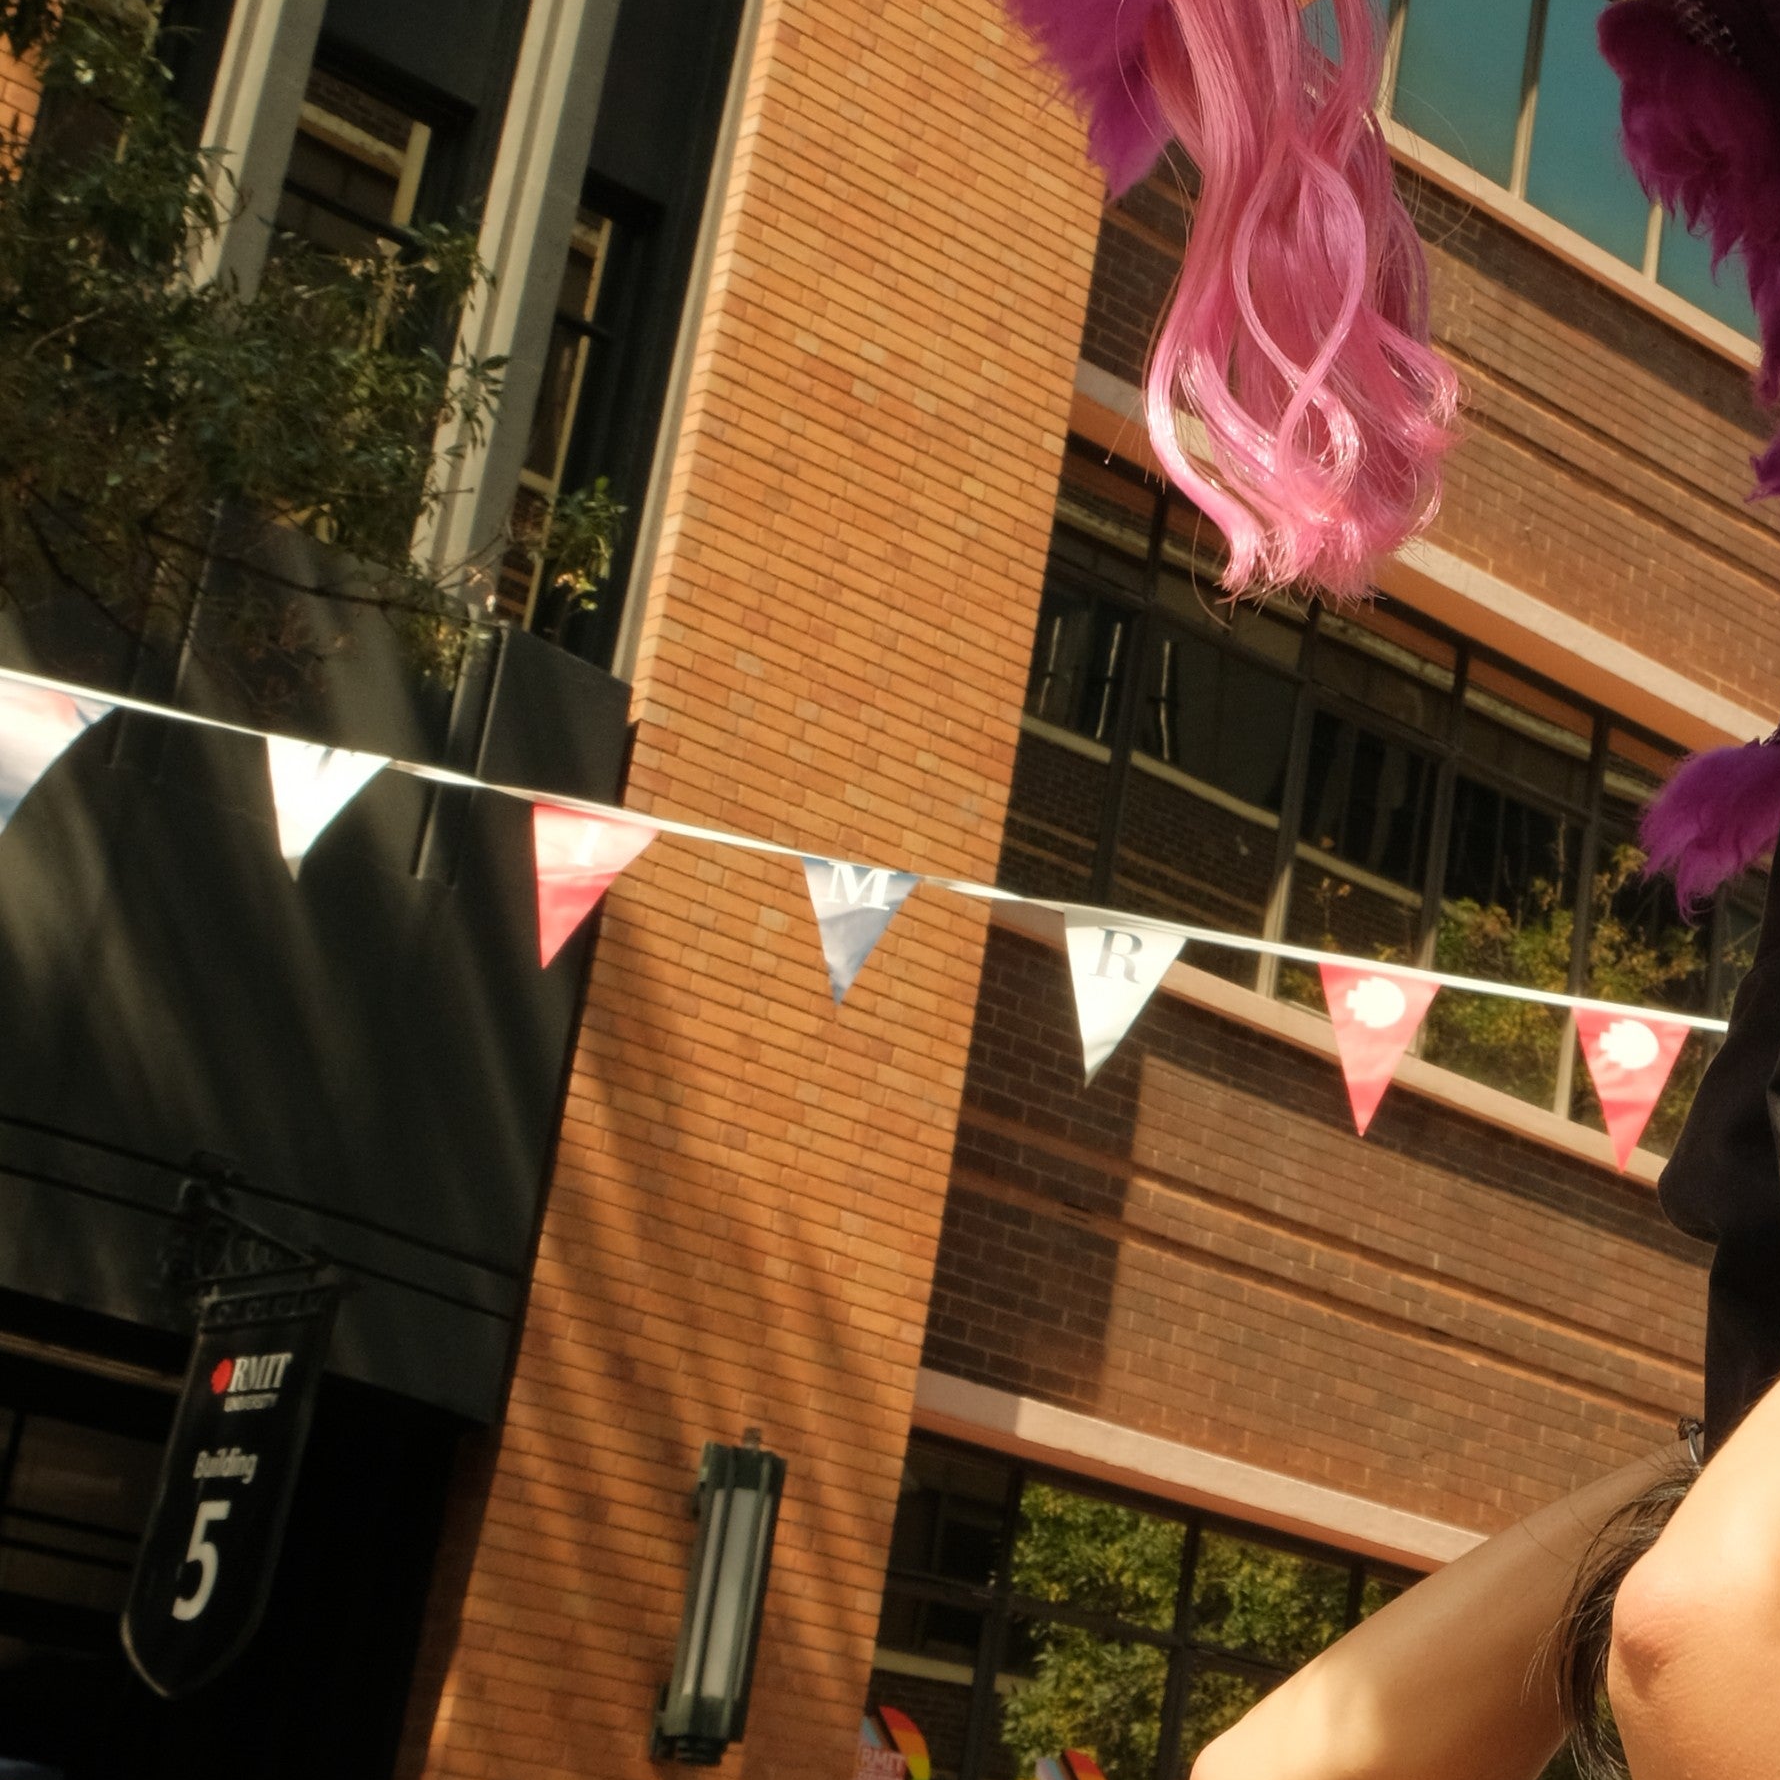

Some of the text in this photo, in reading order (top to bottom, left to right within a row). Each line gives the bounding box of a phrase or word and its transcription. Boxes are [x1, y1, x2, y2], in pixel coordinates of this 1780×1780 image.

[823, 862, 898, 911] M
[1088, 925, 1144, 985] R
[227, 1352, 293, 1392] RMIT
[192, 1445, 259, 1484] Building
[171, 1500, 231, 1621] 5
